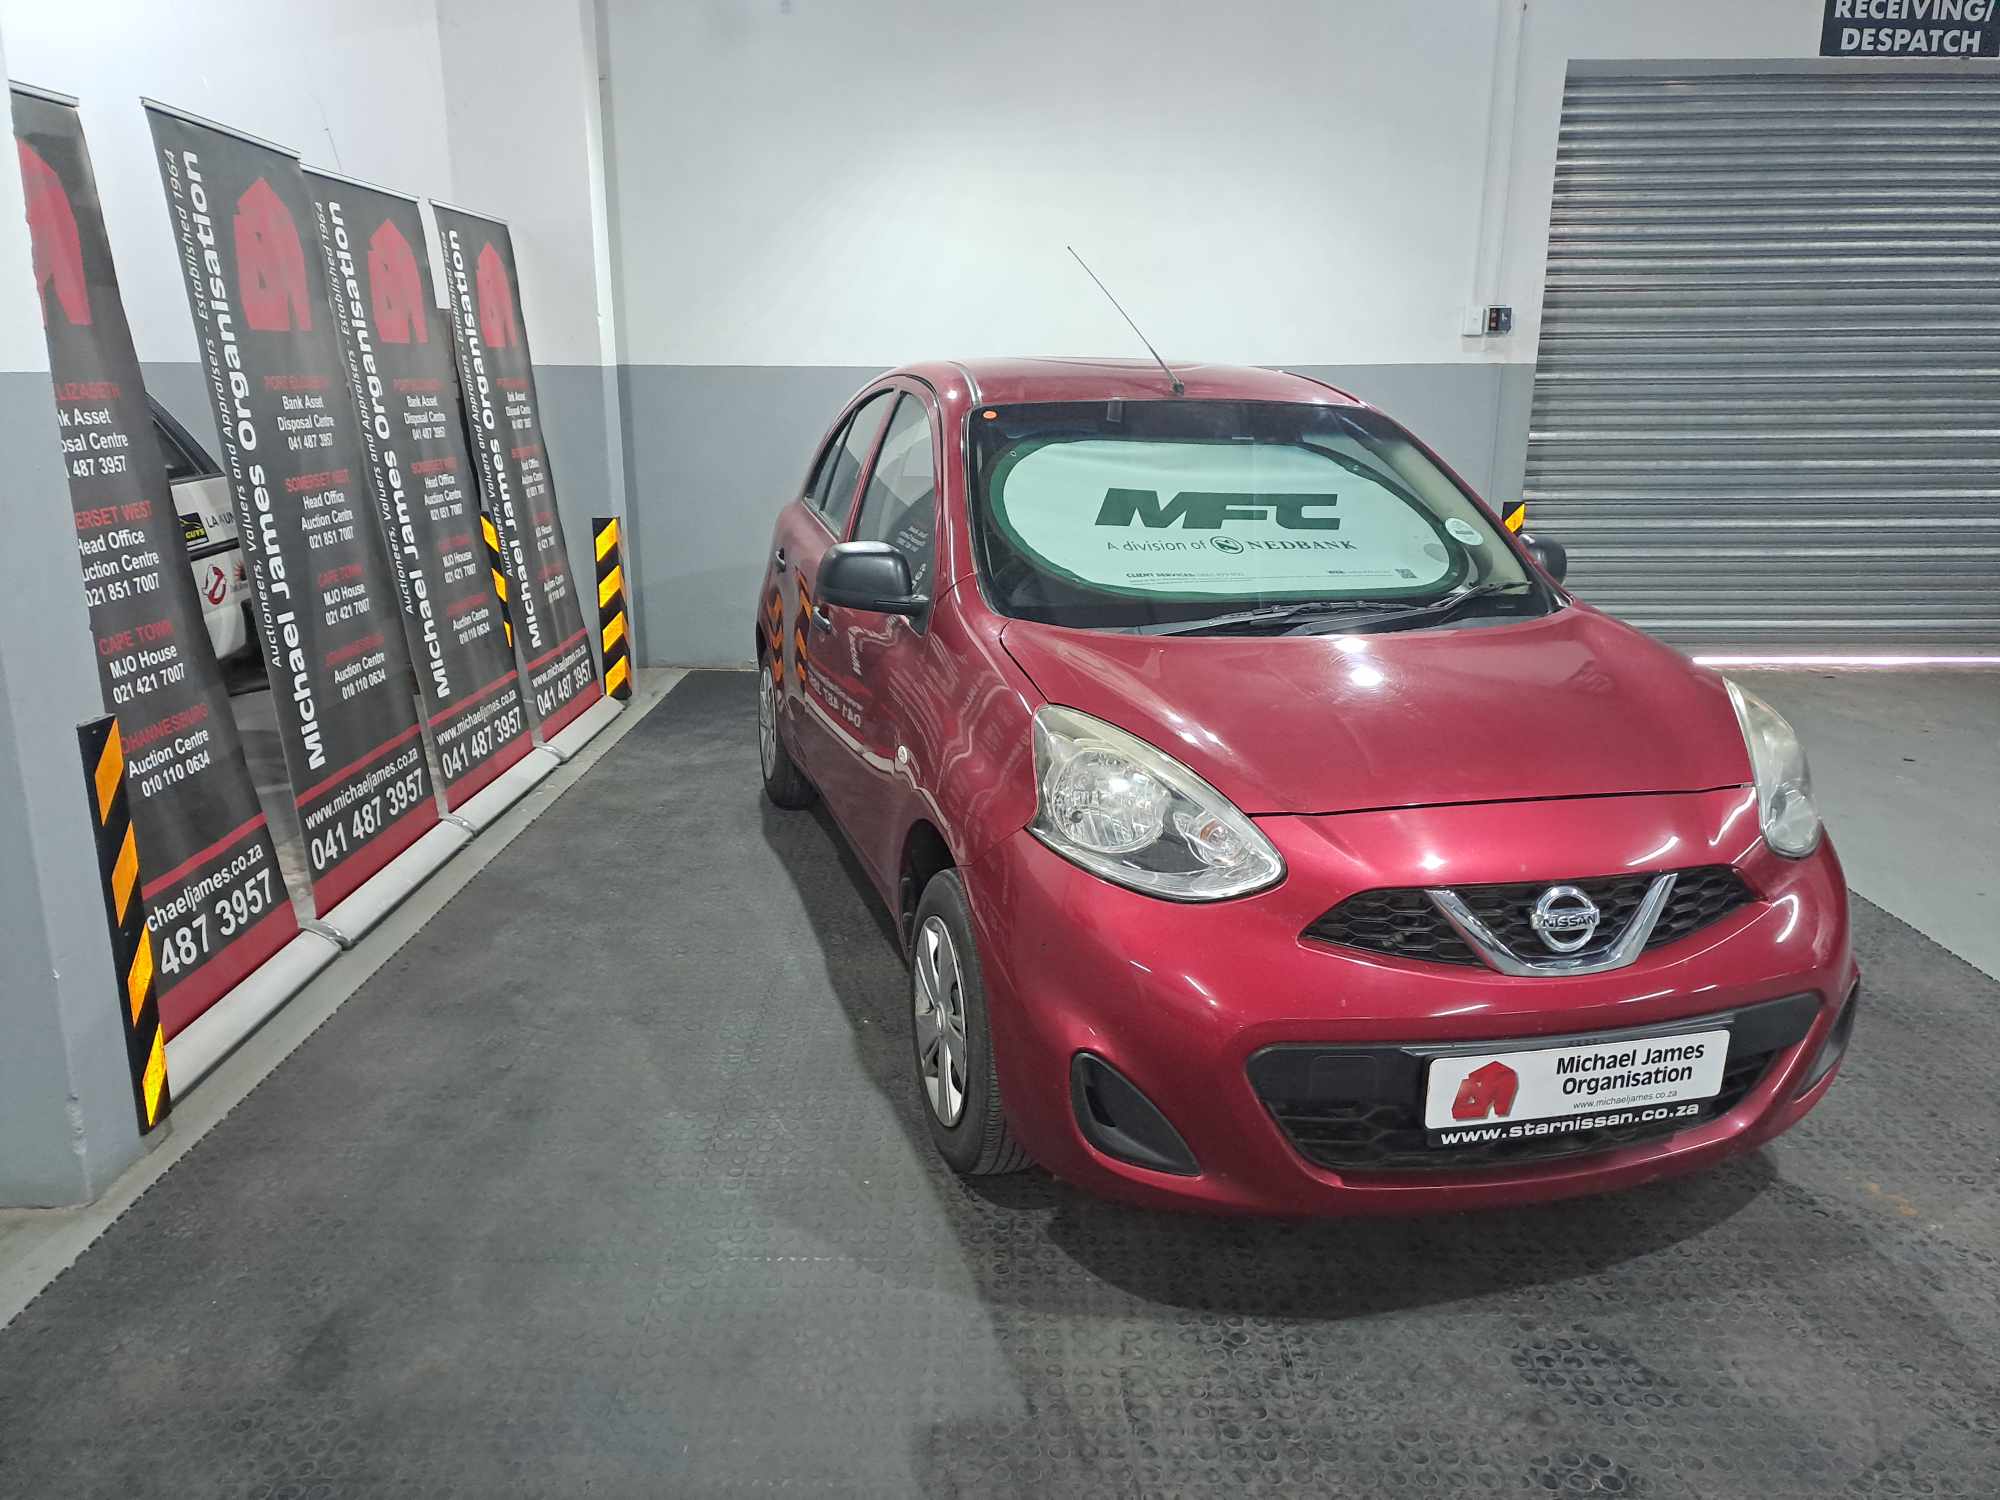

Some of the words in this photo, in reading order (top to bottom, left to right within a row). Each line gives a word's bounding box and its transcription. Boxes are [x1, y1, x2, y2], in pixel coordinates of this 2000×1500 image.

[1834, 0, 1995, 22] RECEIVING/
[1840, 28, 1982, 53] DESPATCH
[164, 148, 184, 200] 1964
[175, 204, 209, 321] Established
[183, 151, 257, 451] Organisation
[322, 246, 350, 335] Established
[328, 201, 390, 440] Organisation
[449, 230, 495, 430] Organisation
[206, 338, 233, 438] Appraisers
[74, 408, 112, 425] Asset
[89, 431, 129, 449] Centre
[72, 459, 95, 477] 487
[99, 455, 127, 474] 3957
[226, 443, 242, 480] and
[364, 432, 378, 462] and
[373, 466, 391, 521] Valuers
[384, 450, 419, 560] James
[490, 439, 517, 531] James
[1094, 487, 1341, 530] MFC
[108, 529, 145, 549] Office
[236, 485, 257, 552] Valuers
[249, 464, 290, 600] James
[121, 551, 159, 572] Centre
[1107, 542, 1119, 551] A
[1123, 540, 1187, 552] division
[1191, 540, 1207, 551] of
[1247, 541, 1359, 551] NEDBANK
[86, 587, 106, 607] 021
[108, 578, 131, 600] 851
[133, 573, 160, 596] 7007
[253, 560, 283, 668] Auctioneers,
[509, 539, 542, 649] Michael
[409, 569, 450, 699] Michael
[109, 656, 137, 679] MJO
[139, 644, 178, 666] House
[112, 682, 134, 704] 021
[137, 674, 158, 695] 421
[159, 663, 185, 686] 7007
[277, 611, 326, 770] Michael
[537, 687, 557, 716] 041
[557, 674, 572, 704] 487
[574, 659, 593, 692] 3957
[128, 748, 174, 779] Auction
[175, 728, 210, 755] Centre
[442, 747, 469, 780] 041
[471, 725, 493, 760] 487
[494, 706, 520, 744] 3957
[141, 775, 163, 798] 010
[163, 761, 184, 786] 110
[185, 749, 211, 776] 0634
[305, 746, 419, 831] www.michaeljames.co.za
[311, 822, 348, 871] 041
[352, 795, 382, 841] 487
[386, 768, 424, 817] 3957
[160, 914, 209, 975] 487
[215, 867, 272, 936] 3957
[1543, 914, 1596, 928] NISSAN
[1556, 1049, 1637, 1075] Michael
[1642, 1042, 1705, 1067] James
[1562, 1064, 1692, 1096] Organisation
[1440, 1102, 1699, 1145] www.starnissan.co.za
[1573, 1089, 1678, 1110] www.michaeljames.co.za
